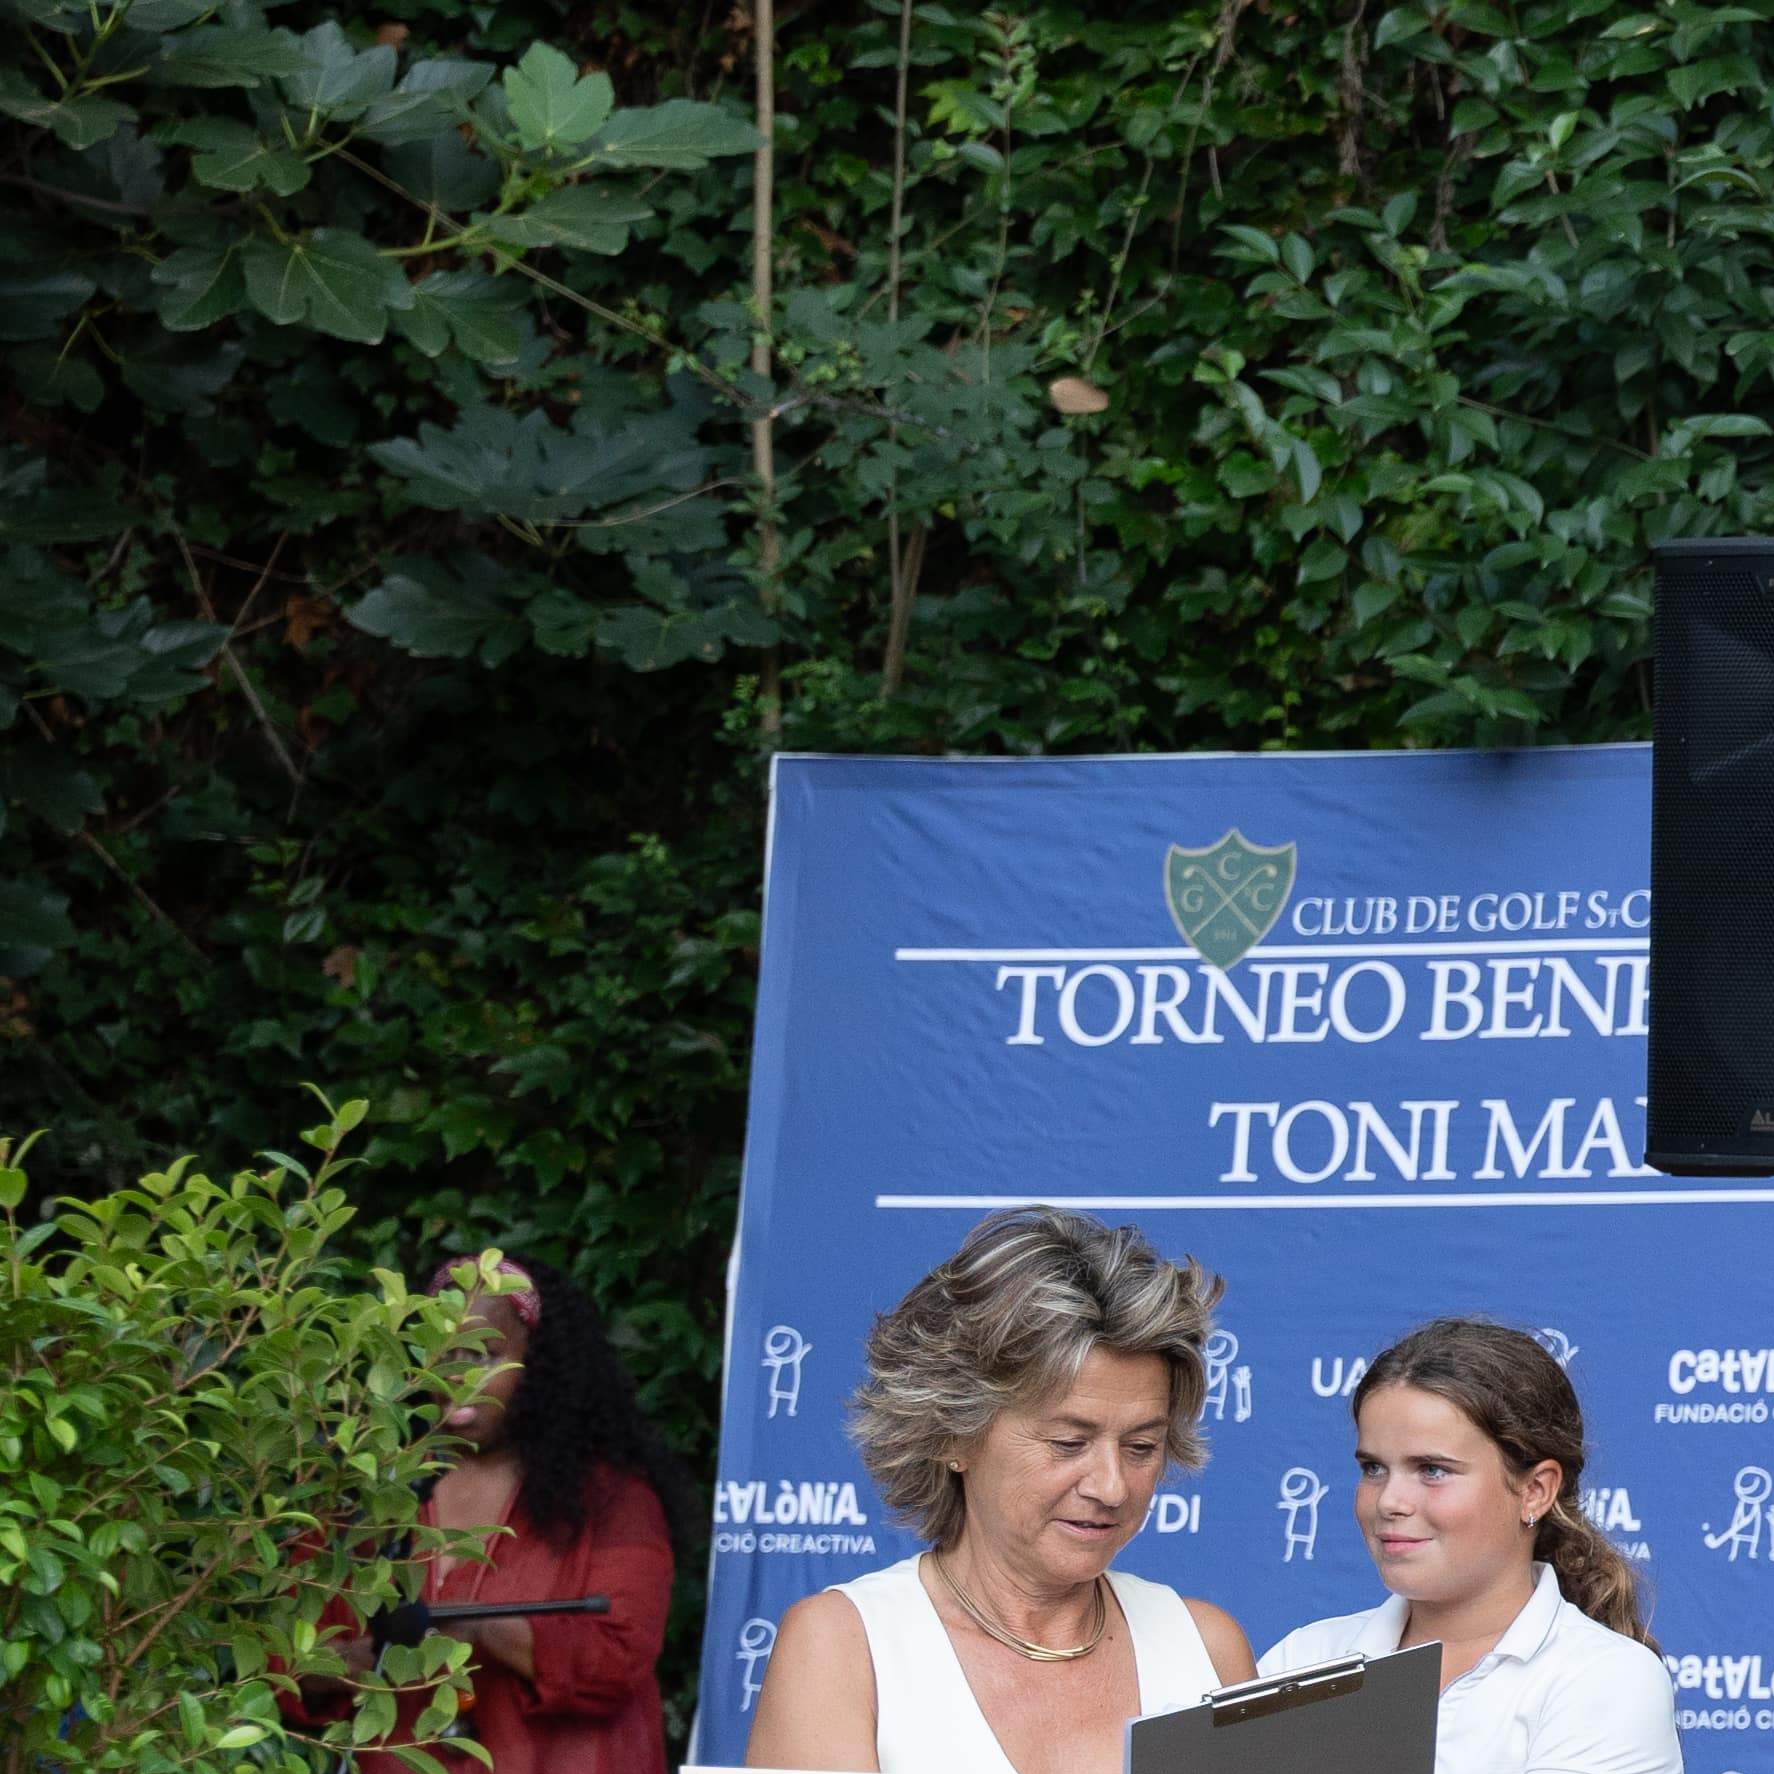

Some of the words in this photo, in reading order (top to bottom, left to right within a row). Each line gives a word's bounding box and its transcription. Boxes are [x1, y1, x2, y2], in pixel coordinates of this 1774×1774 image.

[1293, 896, 1399, 936] CLUB
[1406, 894, 1461, 933] DE
[1468, 891, 1581, 932] GOLF
[997, 959, 1407, 1046] TORNEO
[1208, 1099, 1459, 1184] TONI
[1473, 1096, 1652, 1180] MA
[1654, 1401, 1768, 1425] FUNDACIÓ
[760, 1532, 876, 1555] CREACTIVA
